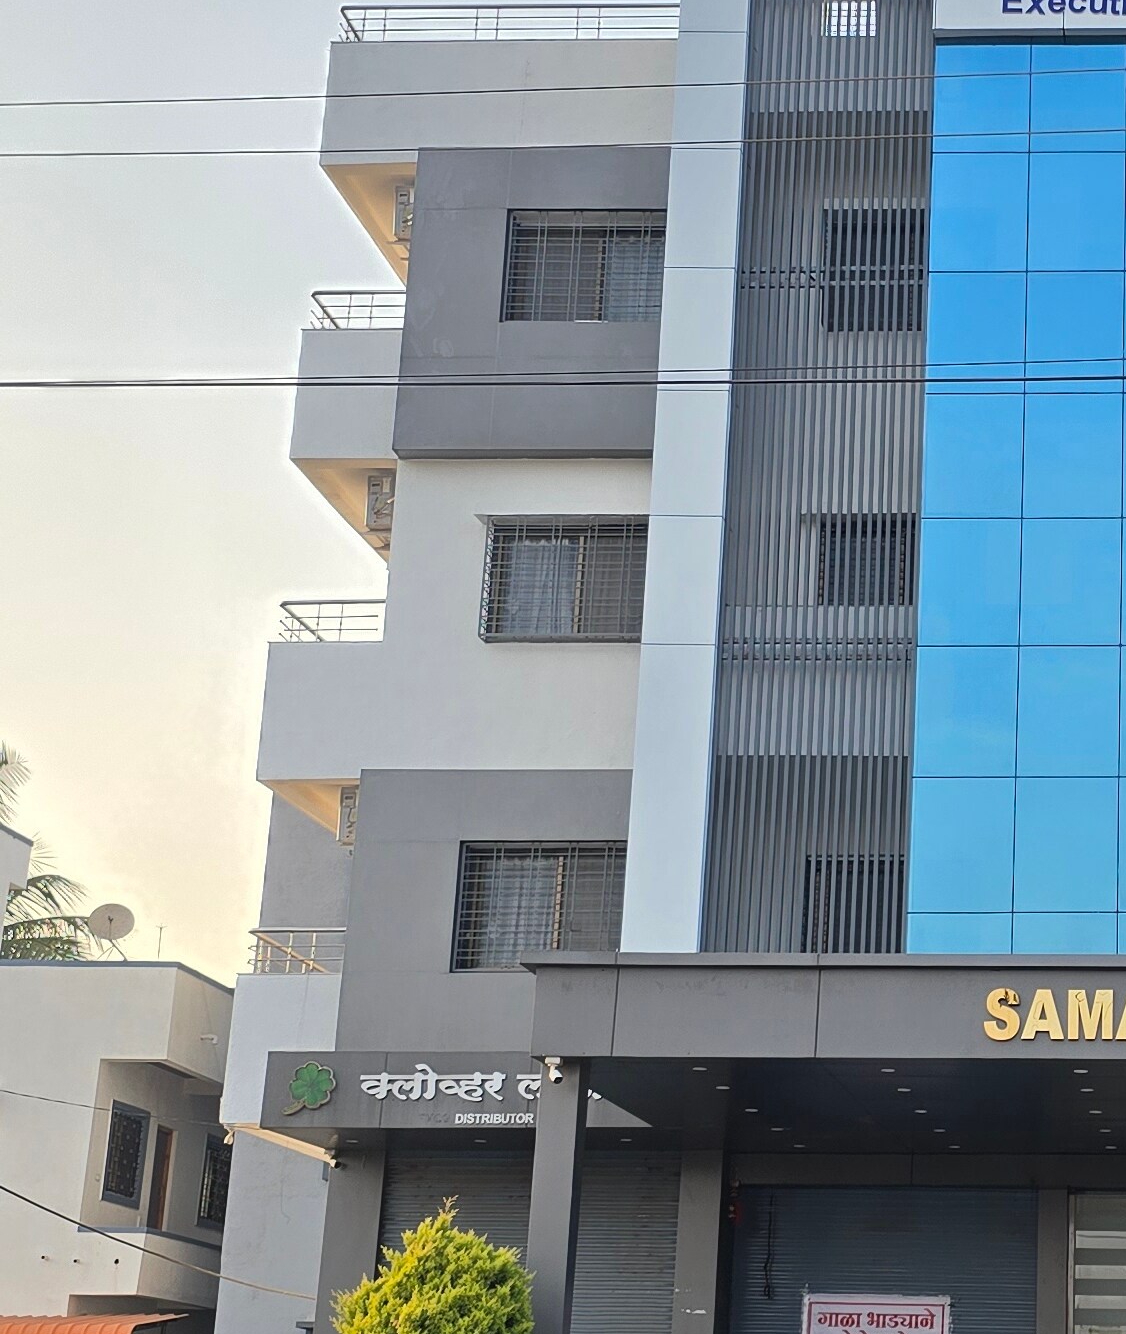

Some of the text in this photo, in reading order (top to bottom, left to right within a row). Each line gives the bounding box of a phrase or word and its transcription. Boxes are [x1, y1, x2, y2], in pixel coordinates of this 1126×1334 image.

[360, 1063, 506, 1102] क्लोव्हर
[455, 1113, 535, 1125] DISTRIBUTOR
[817, 1308, 936, 1329] गाळा भाड्याने
